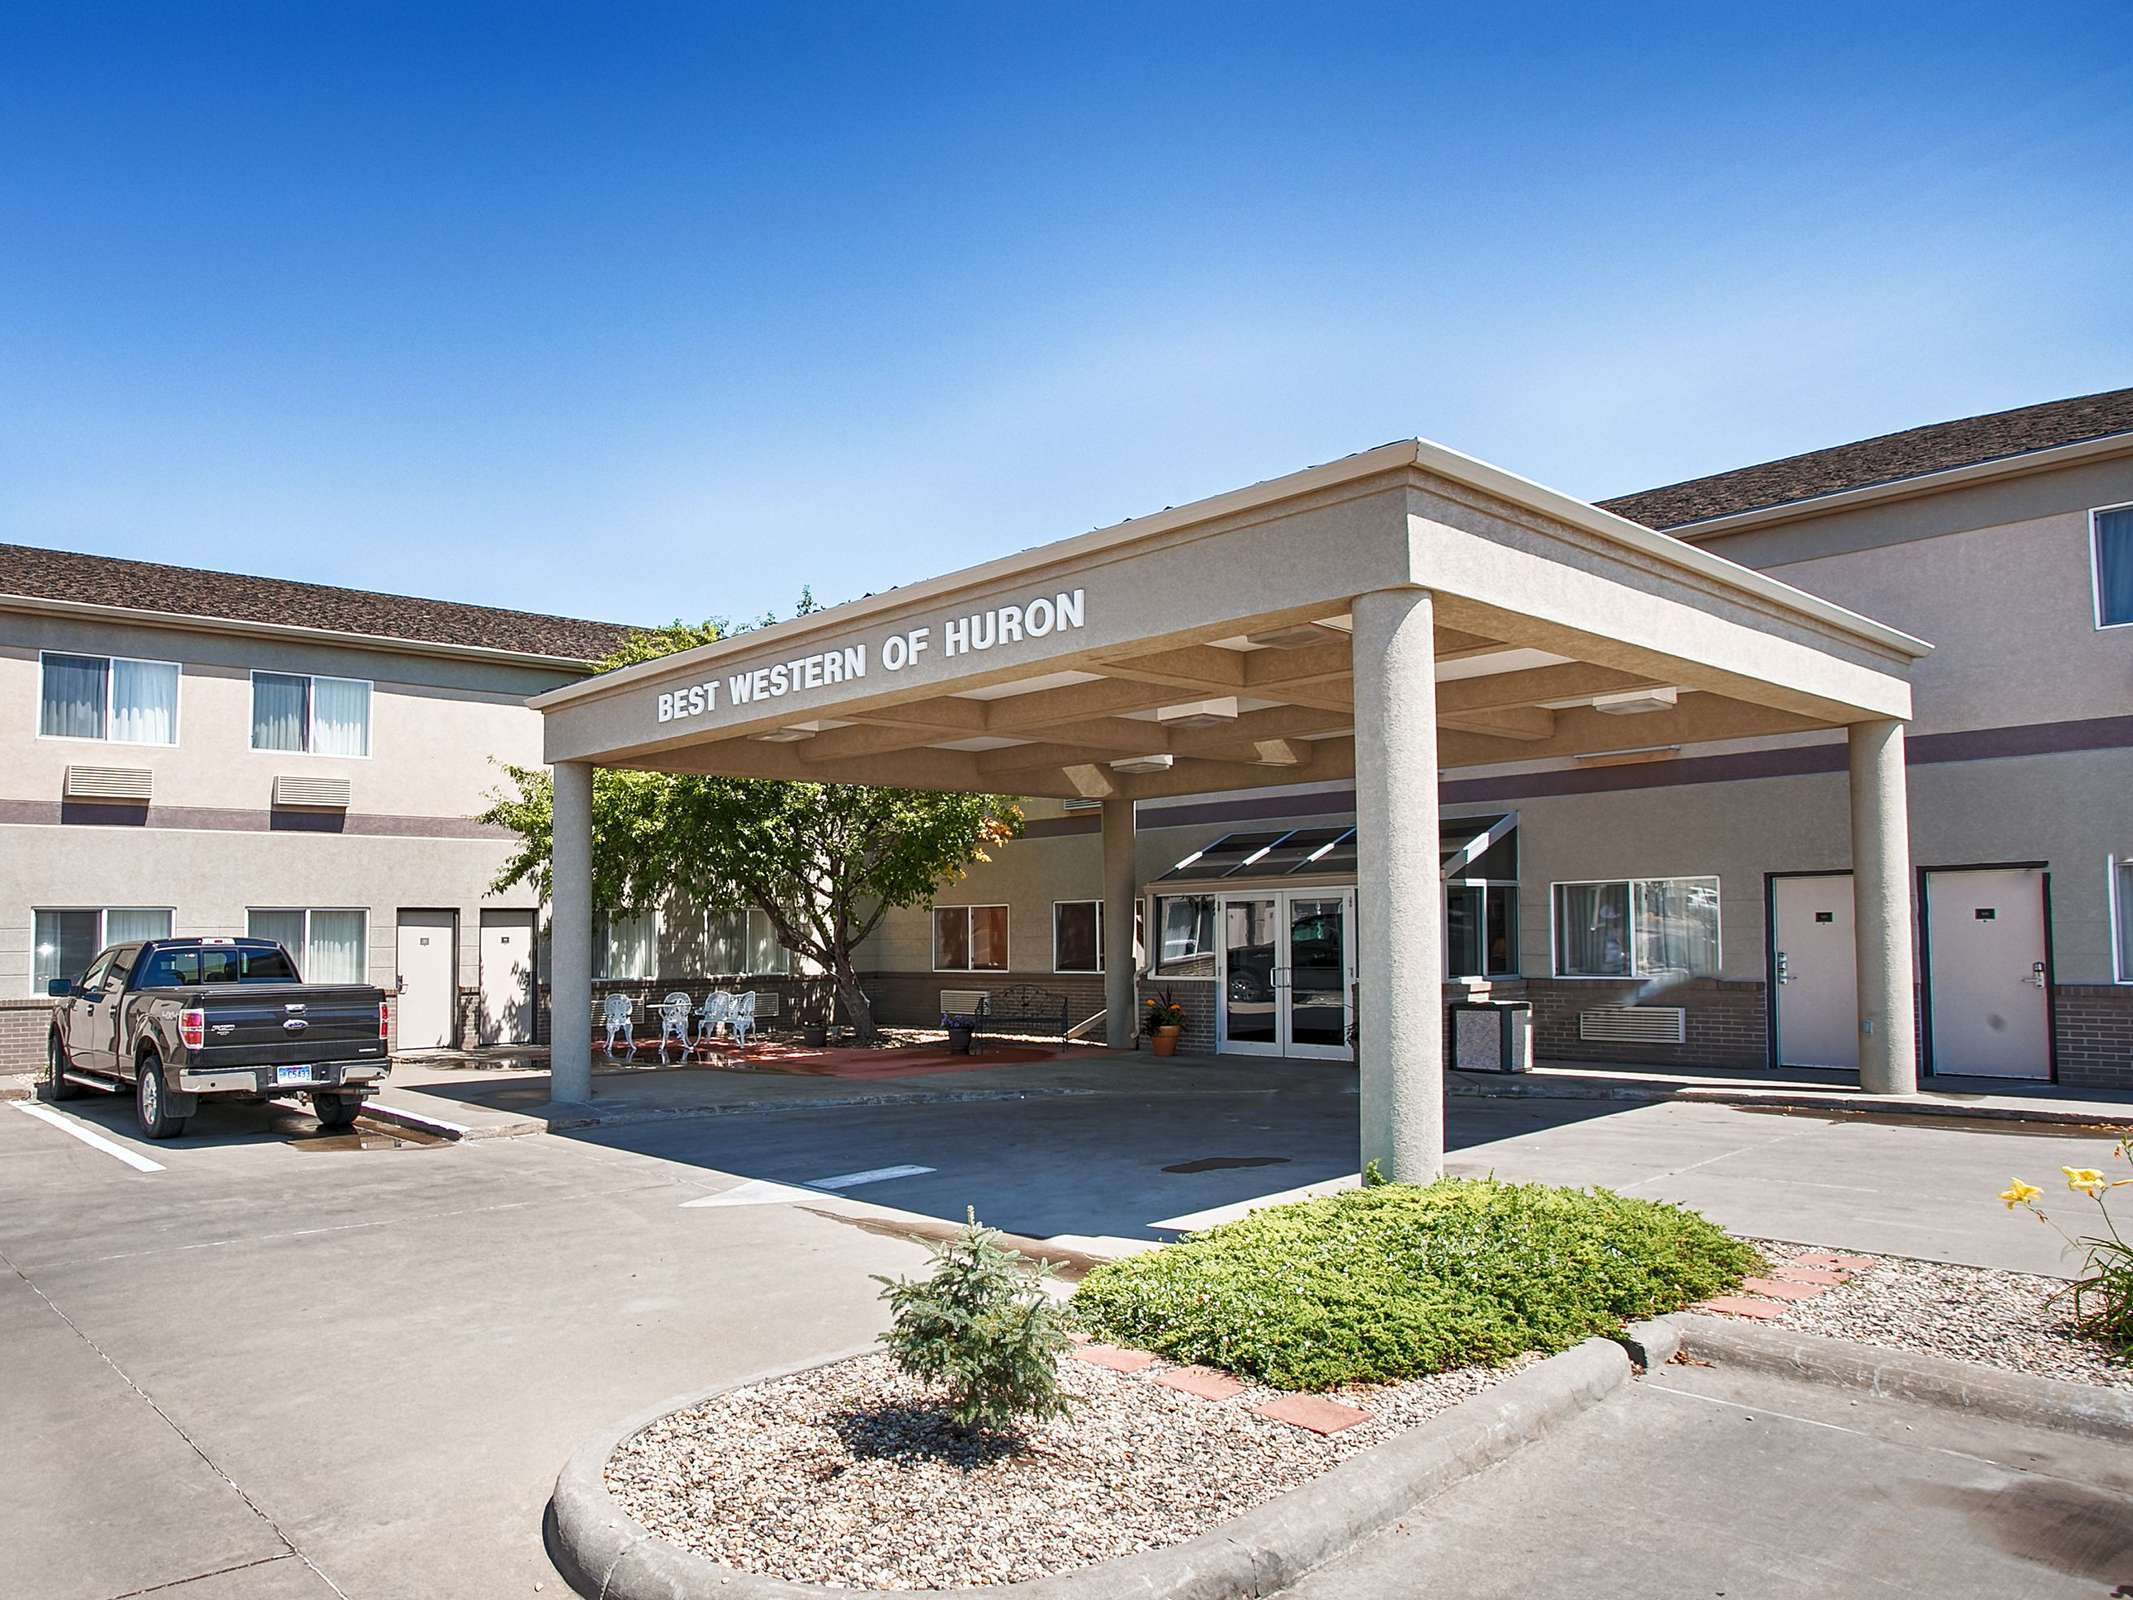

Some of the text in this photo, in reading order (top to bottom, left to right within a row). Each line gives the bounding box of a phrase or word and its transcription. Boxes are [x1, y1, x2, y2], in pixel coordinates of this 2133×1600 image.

[658, 589, 1085, 722] BEST WESTERN OF HURON
